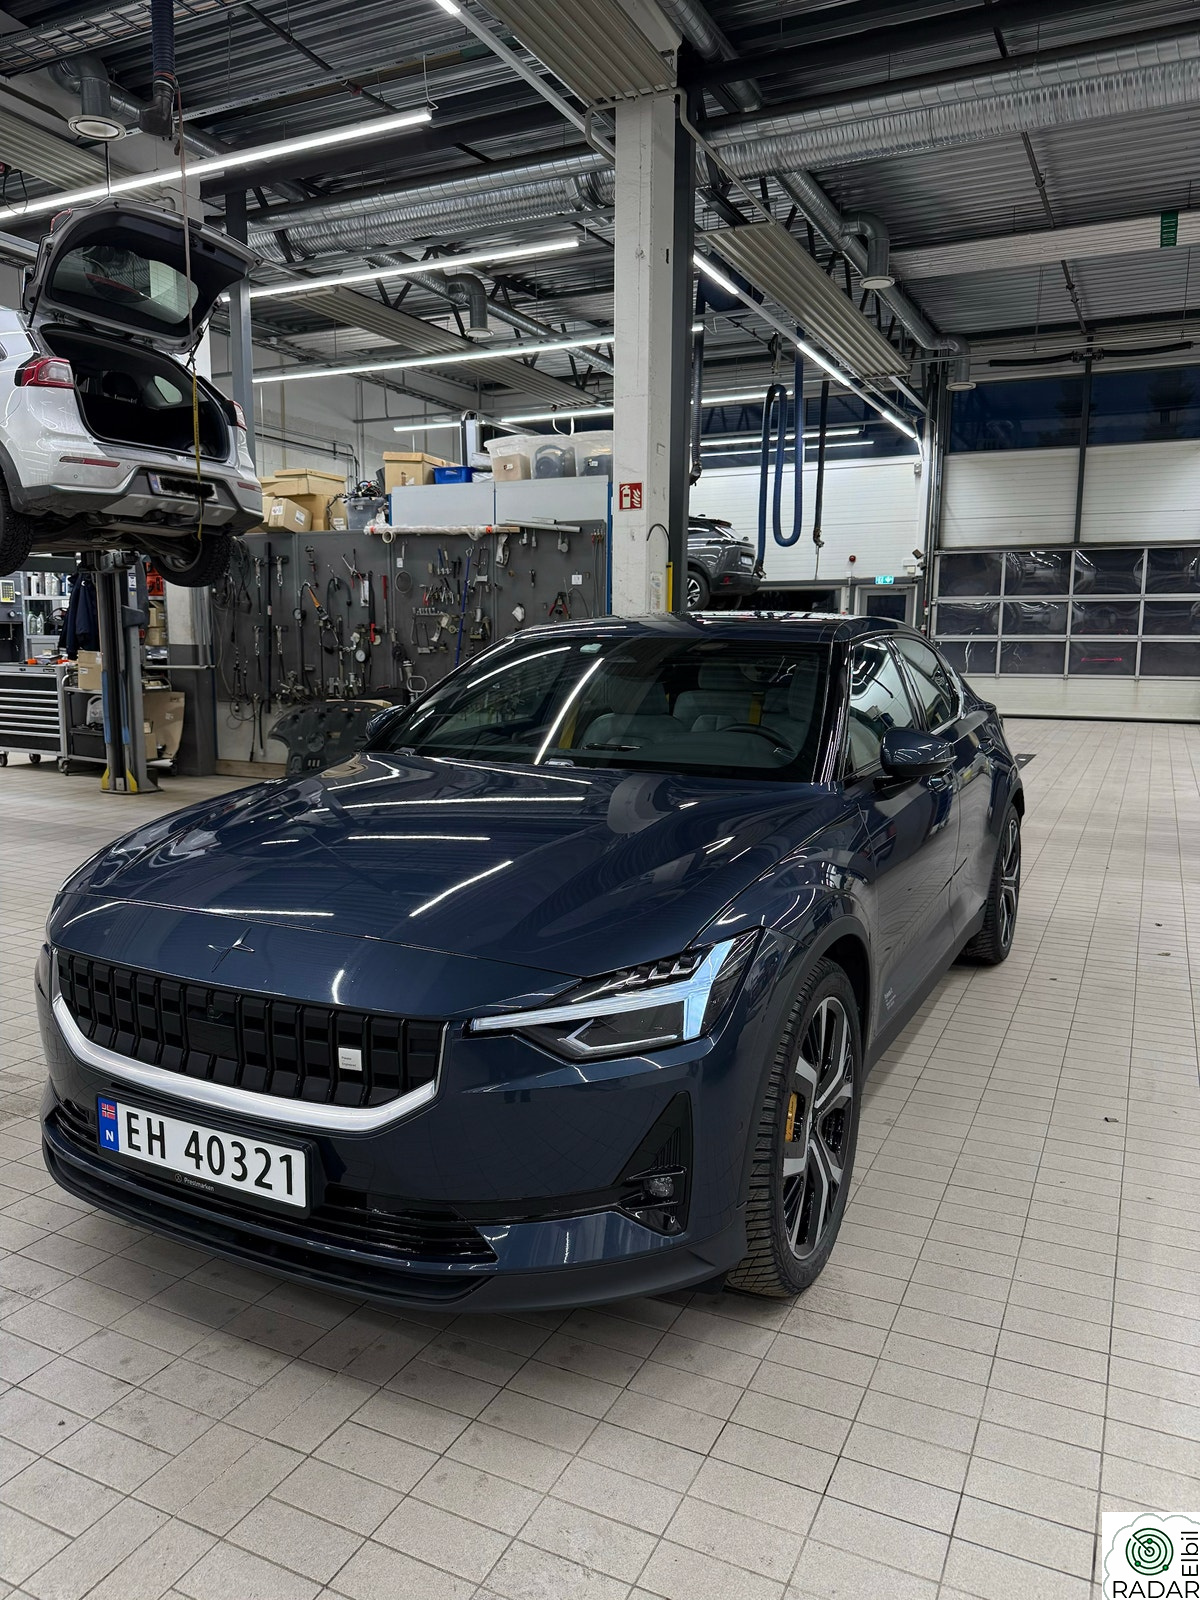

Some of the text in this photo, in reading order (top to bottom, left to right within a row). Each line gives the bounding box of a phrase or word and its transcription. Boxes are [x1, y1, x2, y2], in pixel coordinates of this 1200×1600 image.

[105, 1129, 114, 1142] N
[126, 1111, 294, 1196] EH 40321
[184, 1176, 215, 1192] Prestmarken
